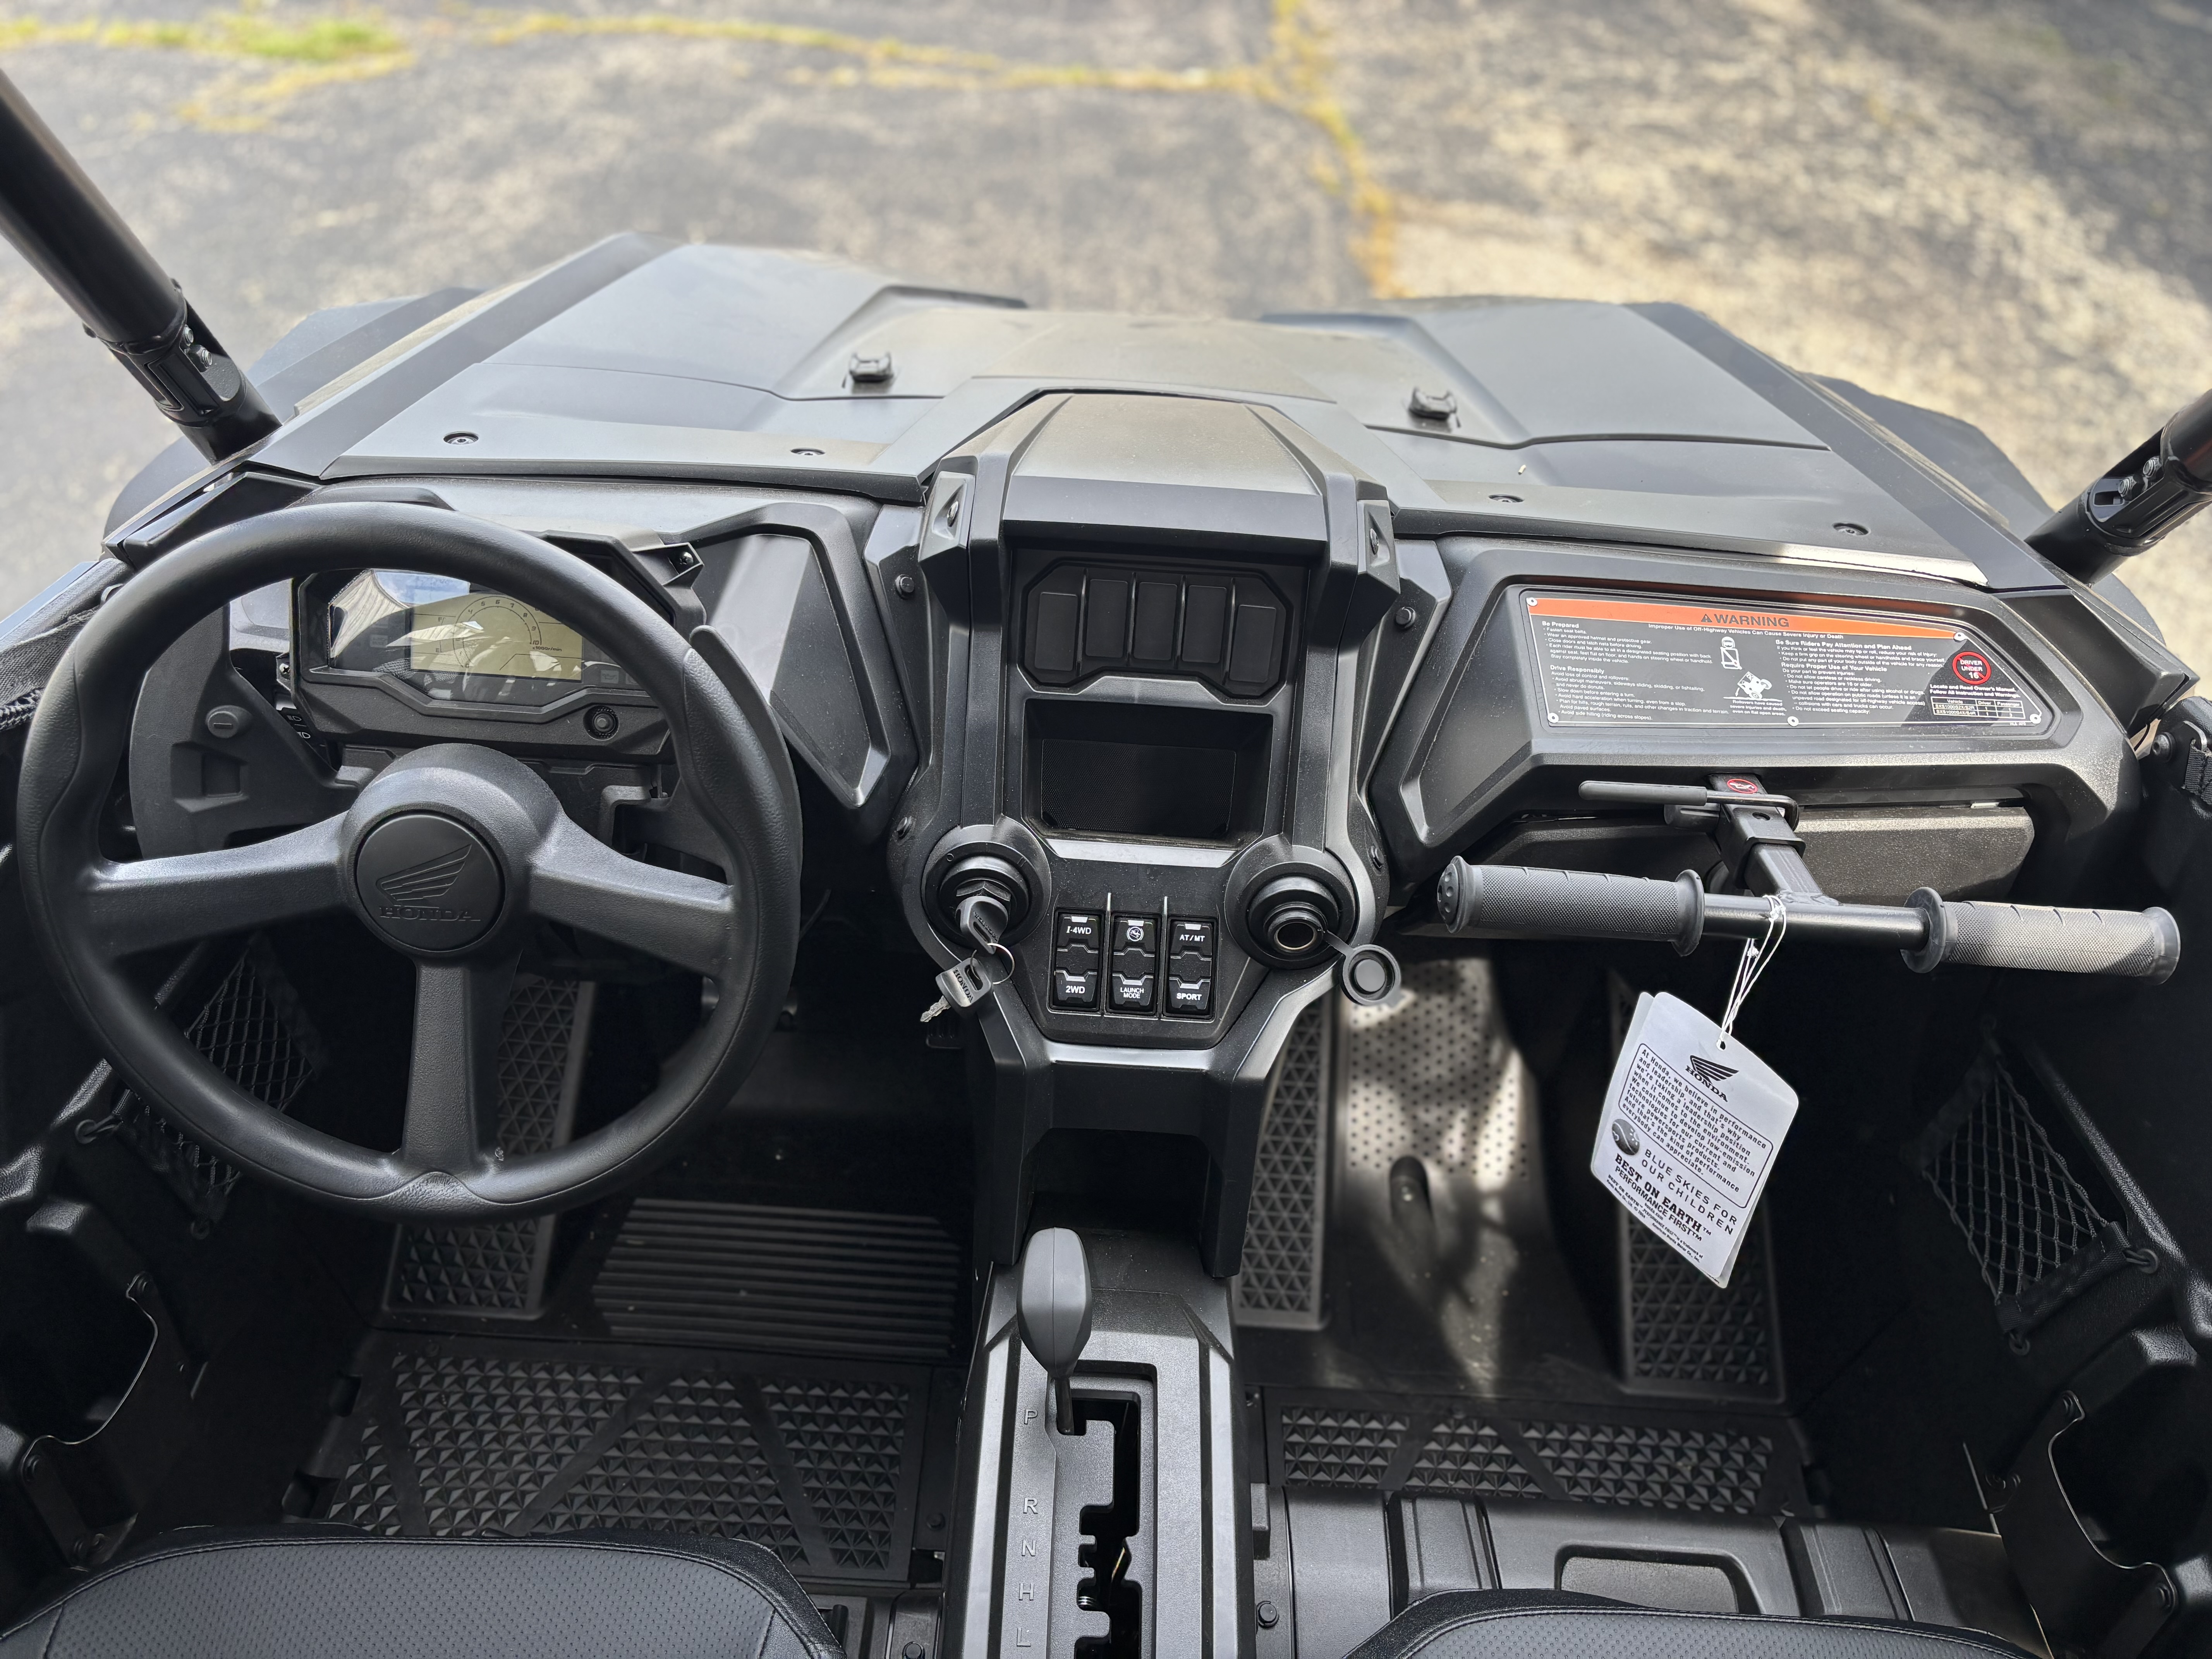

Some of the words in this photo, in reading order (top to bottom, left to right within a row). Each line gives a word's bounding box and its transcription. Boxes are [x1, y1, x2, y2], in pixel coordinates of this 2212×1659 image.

[1714, 614, 1789, 627] WARNING
[1567, 666, 1604, 675] Responsibly
[379, 906, 481, 921] HONDA
[1066, 926, 1091, 934] I-4WD
[1176, 993, 1202, 1001] SPORT
[1639, 1055, 1650, 1069] and
[1651, 1066, 1687, 1101] leadership,
[1689, 1097, 1702, 1111] and
[1703, 1109, 1725, 1129] that's
[1726, 1127, 1741, 1142] why
[1642, 1048, 1649, 1058] At
[1650, 1056, 1672, 1079] Honda,
[1673, 1077, 1682, 1087] we
[1684, 1085, 1709, 1108] believe
[1710, 1105, 1717, 1115] in
[1719, 1112, 1766, 1151] performance
[1685, 1065, 1728, 1102] HONDA
[1627, 1088, 1645, 1109] future
[1646, 1107, 1686, 1145] powersports
[1687, 1140, 1721, 1171] products.
[1628, 1082, 1668, 1121] technologies
[1669, 1117, 1680, 1129] for
[1681, 1128, 1692, 1140] our
[1694, 1137, 1721, 1161] current
[1723, 1159, 1736, 1173] and
[1632, 1075, 1640, 1087] We
[1642, 1084, 1669, 1111] continue
[1671, 1109, 1678, 1119] to
[1679, 1116, 1705, 1142] develop
[1707, 1138, 1755, 1177] low-emission
[1633, 1068, 1649, 1086] when
[1650, 1084, 1656, 1092] it
[1658, 1092, 1678, 1111] comes
[1680, 1108, 1688, 1118] to
[1690, 1116, 1701, 1128] the
[1703, 1126, 1750, 1165] environment.
[1636, 1062, 1653, 1080] we're
[1654, 1078, 1675, 1100] taking
[1682, 1101, 1719, 1134] leadership
[1720, 1130, 1751, 1158] position
[1621, 1101, 1651, 1133] everybody
[1652, 1131, 1664, 1143] can
[1665, 1140, 1705, 1176] appreciate.
[1625, 1095, 1636, 1108] And
[1637, 1106, 1656, 1127] that's
[1657, 1124, 1668, 1137] the
[1669, 1135, 1684, 1150] kind
[1686, 1147, 1693, 1157] of
[1694, 1155, 1740, 1194] performance
[1614, 1153, 1642, 1184] BEST
[1644, 1180, 1659, 1199] ON
[1615, 1165, 1668, 1217] PERFORMANCE
[1641, 1158, 1664, 1182] OUR
[1668, 1180, 1733, 1235] CHILDREN
[1645, 1149, 1672, 1175] BLUE
[1675, 1173, 1710, 1205] SKIES
[1713, 1203, 1737, 1225] FOR
[1024, 1408, 1038, 1425] P
[1023, 1497, 1038, 1514] R
[1021, 1539, 1037, 1556] N
[1018, 1582, 1035, 1601] H
[1016, 1628, 1031, 1647] L
